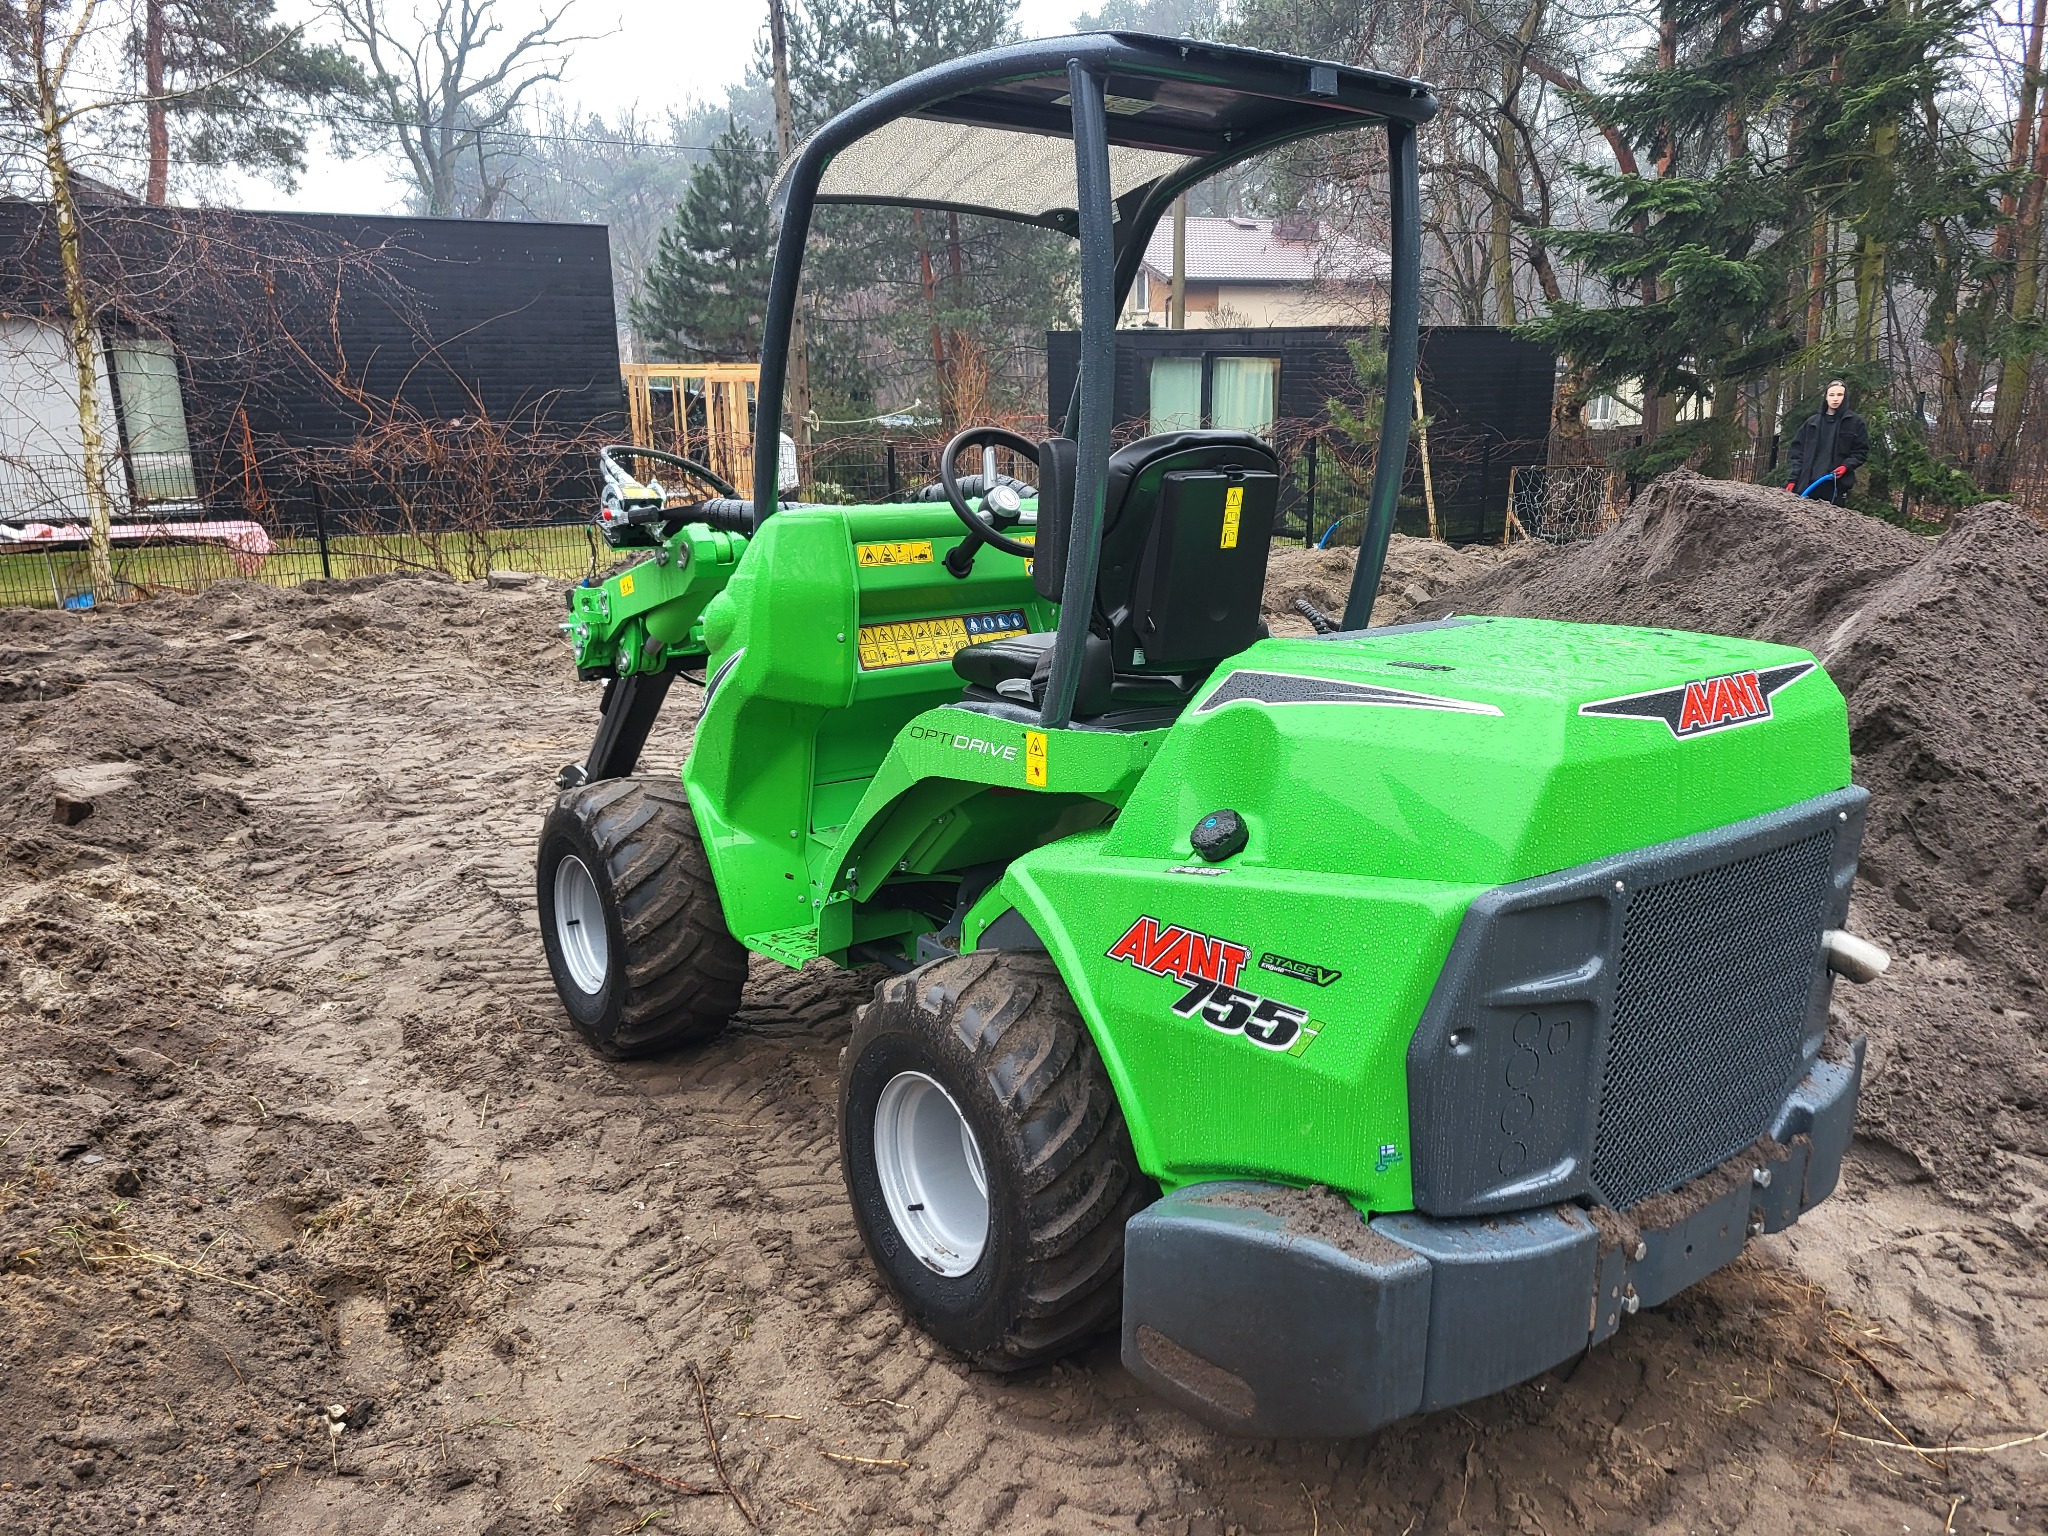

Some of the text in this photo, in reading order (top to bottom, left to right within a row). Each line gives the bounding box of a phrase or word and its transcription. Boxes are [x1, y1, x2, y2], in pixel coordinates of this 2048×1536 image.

[1678, 672, 1768, 731] AVANT
[910, 726, 1018, 761] OPTIDRIVE
[1105, 915, 1251, 988] AVANT
[1262, 954, 1340, 984] STAGE V
